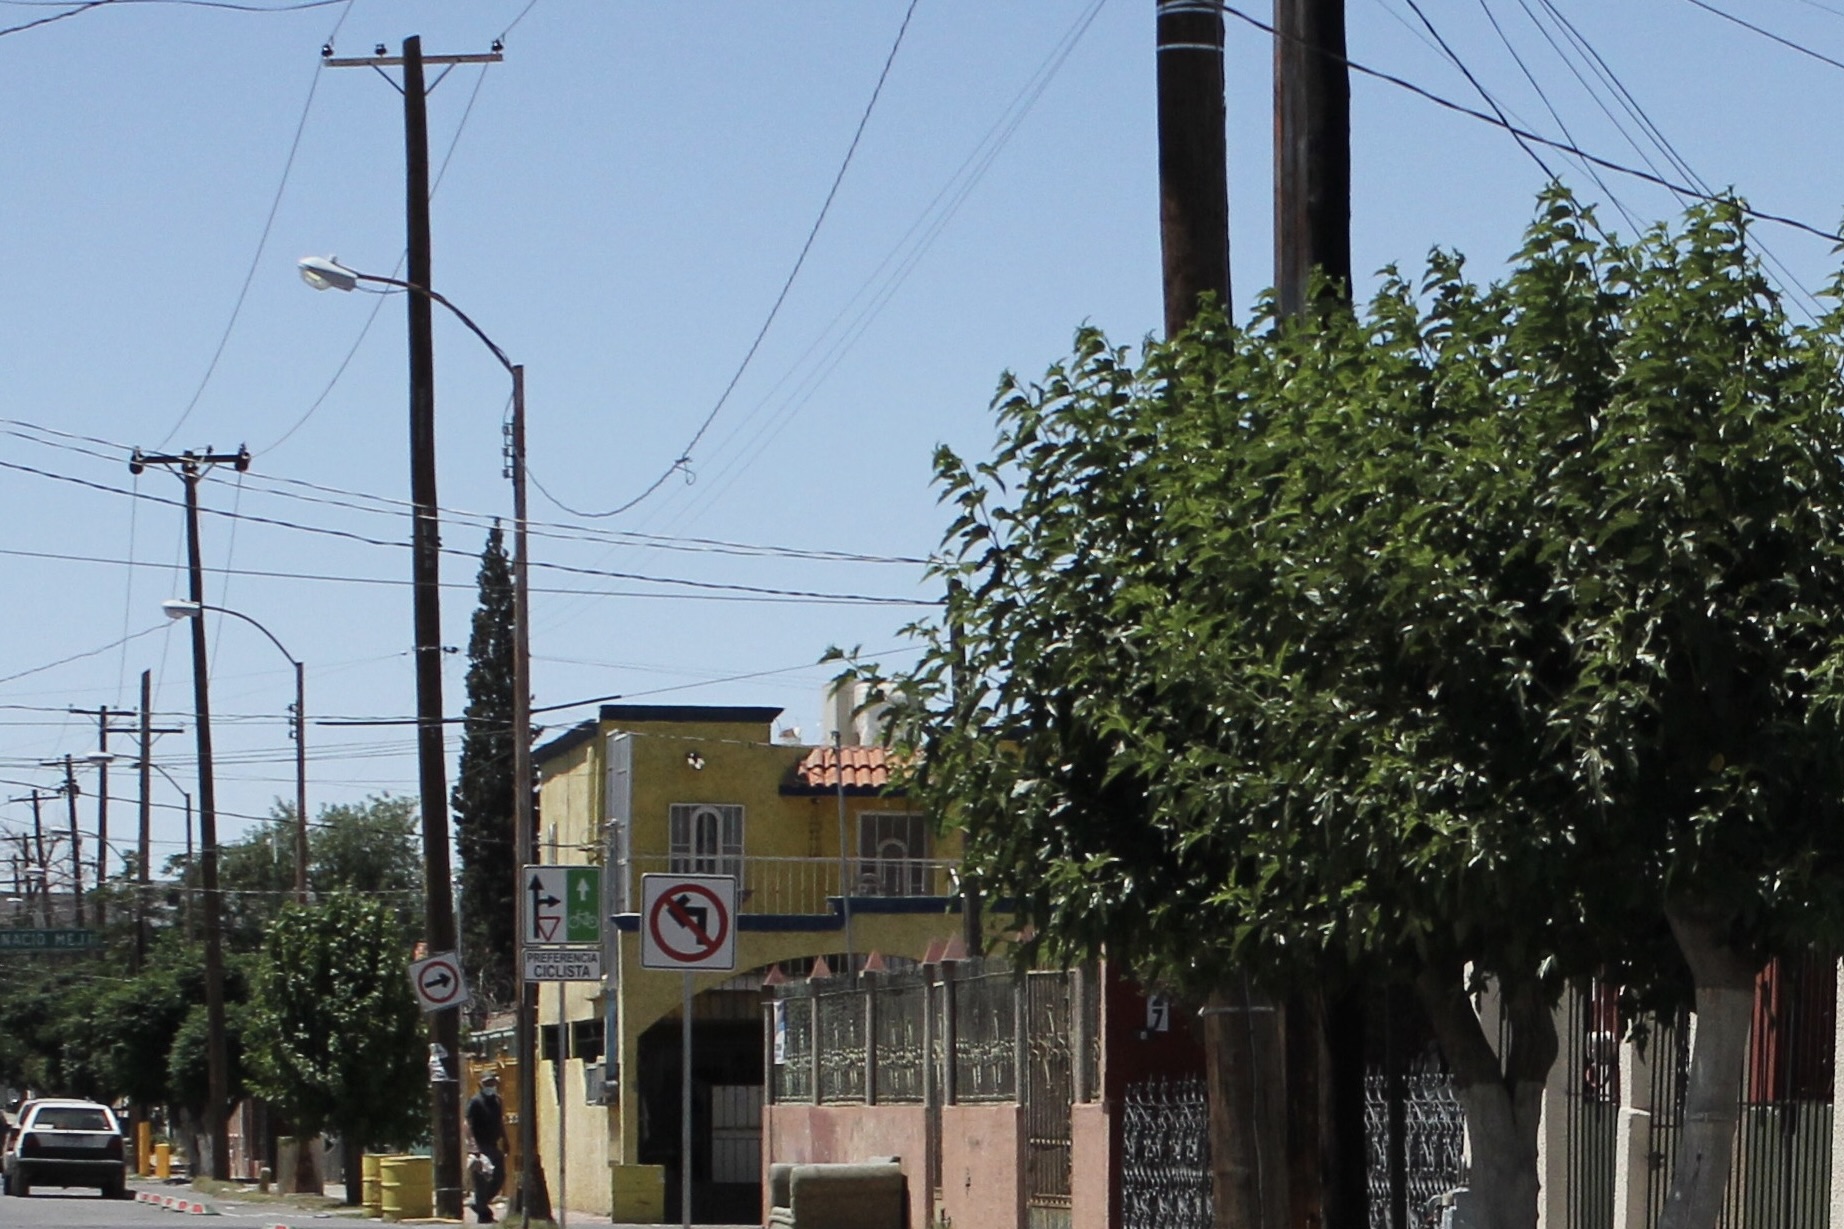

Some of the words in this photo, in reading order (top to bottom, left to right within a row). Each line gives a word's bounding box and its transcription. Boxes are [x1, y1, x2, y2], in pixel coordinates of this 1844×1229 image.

[54, 933, 96, 946] MEJI
[527, 952, 598, 963] PREFERENCIA
[534, 964, 591, 978] CICLISTA
